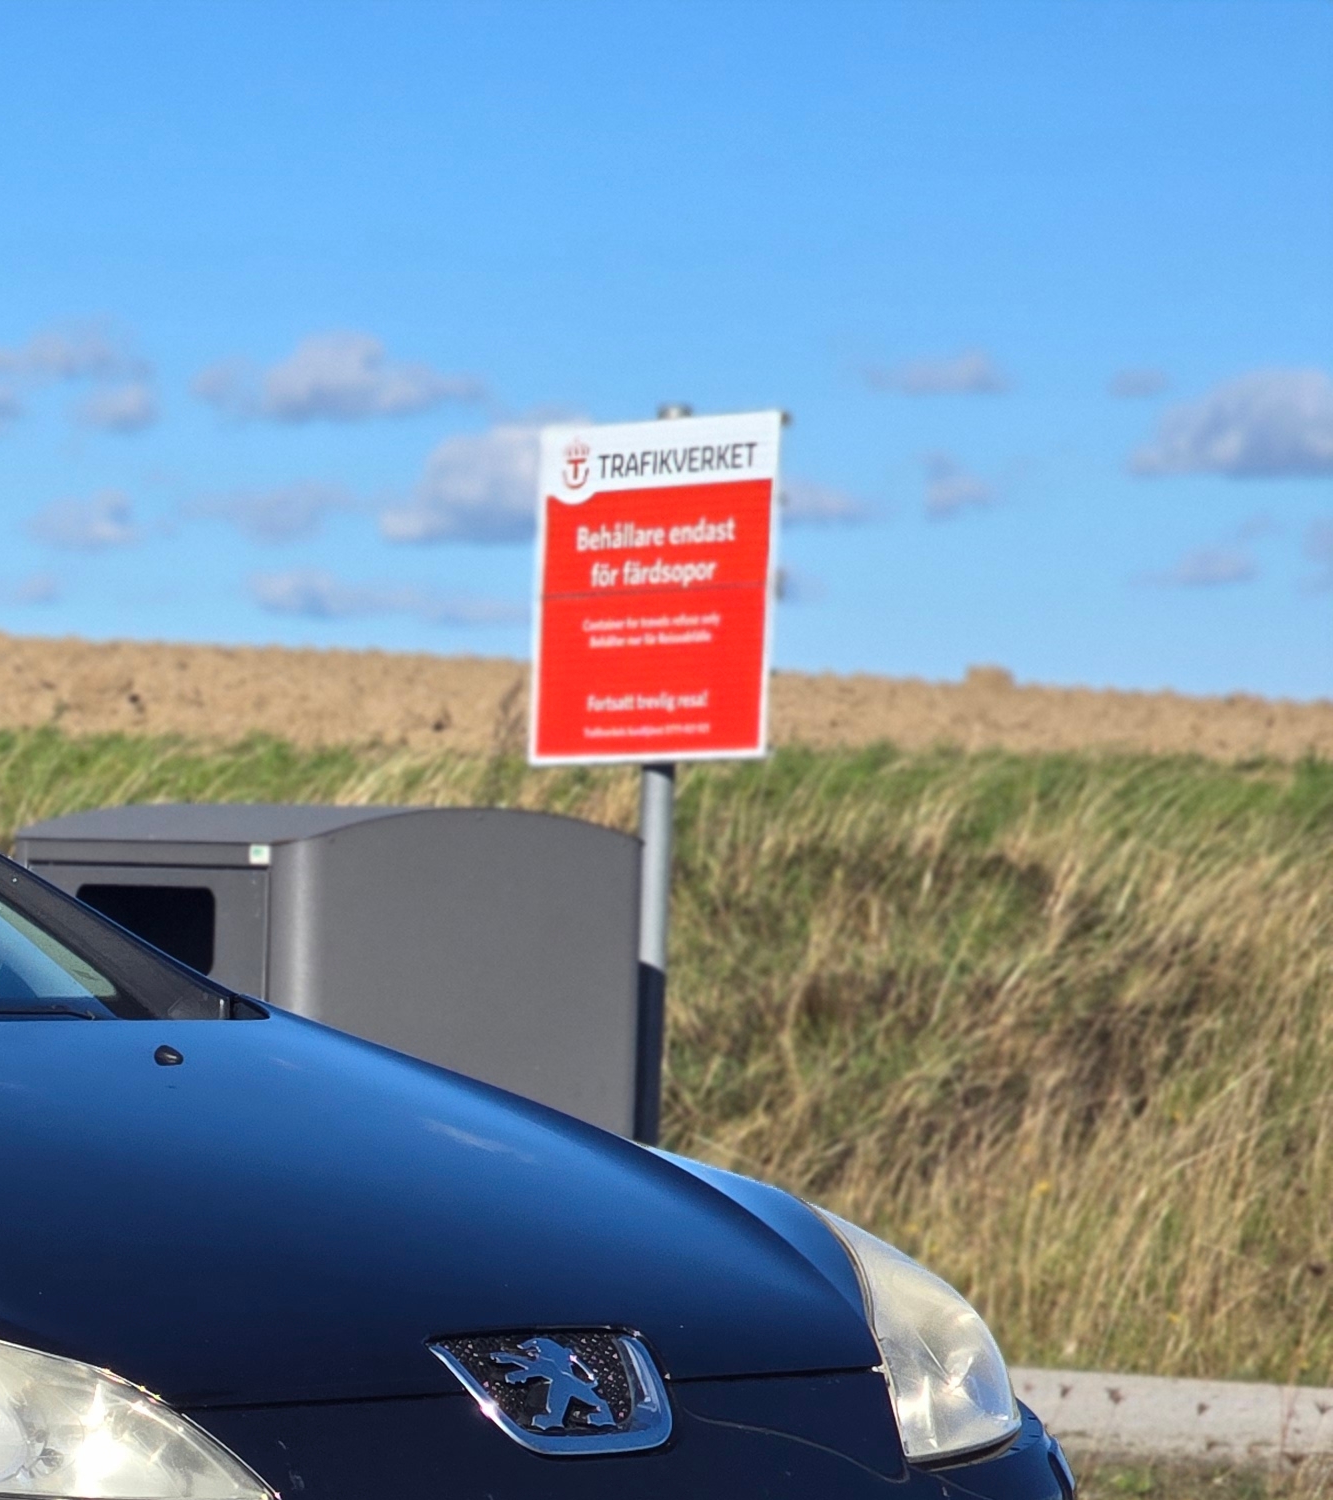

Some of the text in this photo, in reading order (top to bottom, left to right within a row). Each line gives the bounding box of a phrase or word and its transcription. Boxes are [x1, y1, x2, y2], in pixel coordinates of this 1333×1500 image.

[598, 442, 758, 480] TRAFIKVERKET
[577, 516, 736, 551] Behållare endast
[591, 558, 717, 587] för färdsopor
